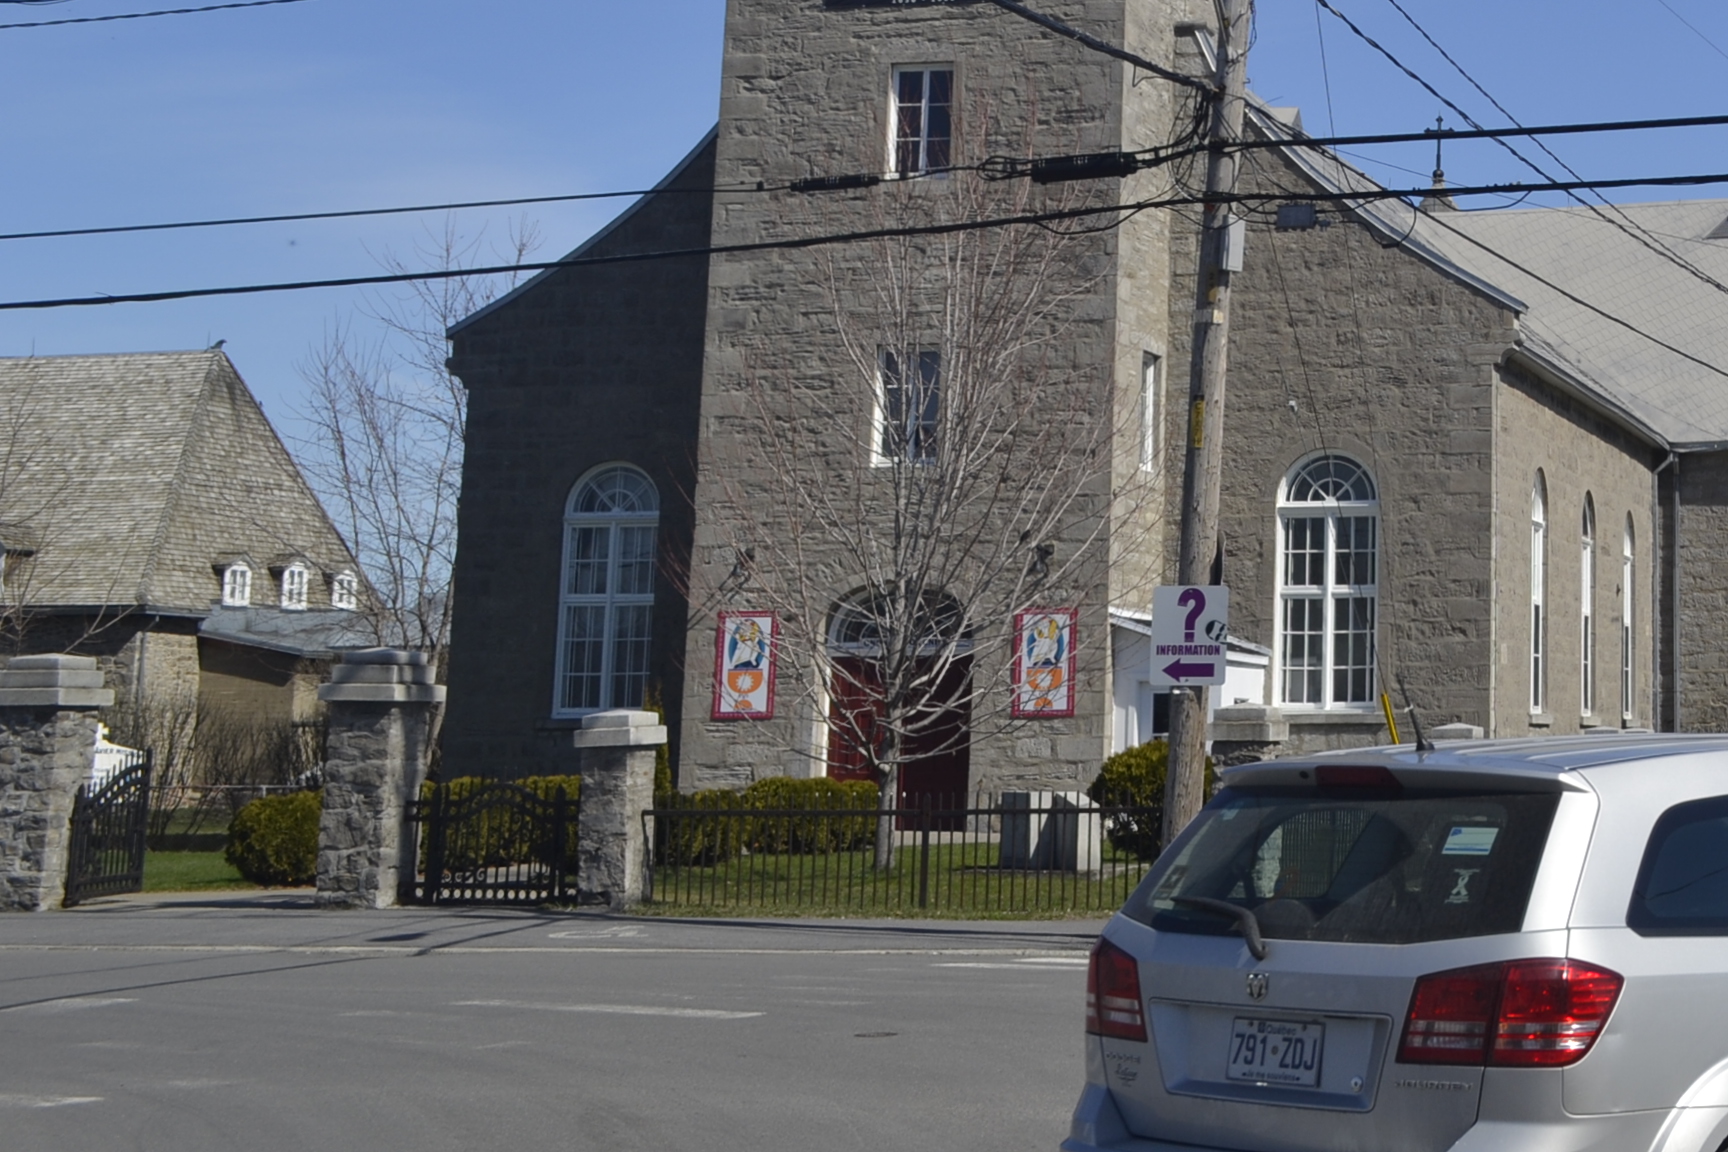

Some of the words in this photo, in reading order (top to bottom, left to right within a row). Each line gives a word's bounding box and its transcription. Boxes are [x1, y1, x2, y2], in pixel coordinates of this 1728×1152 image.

[1156, 644, 1220, 656] INFORMATION
[1232, 1033, 1268, 1066] 791
[1279, 1037, 1317, 1071] ZDJ
